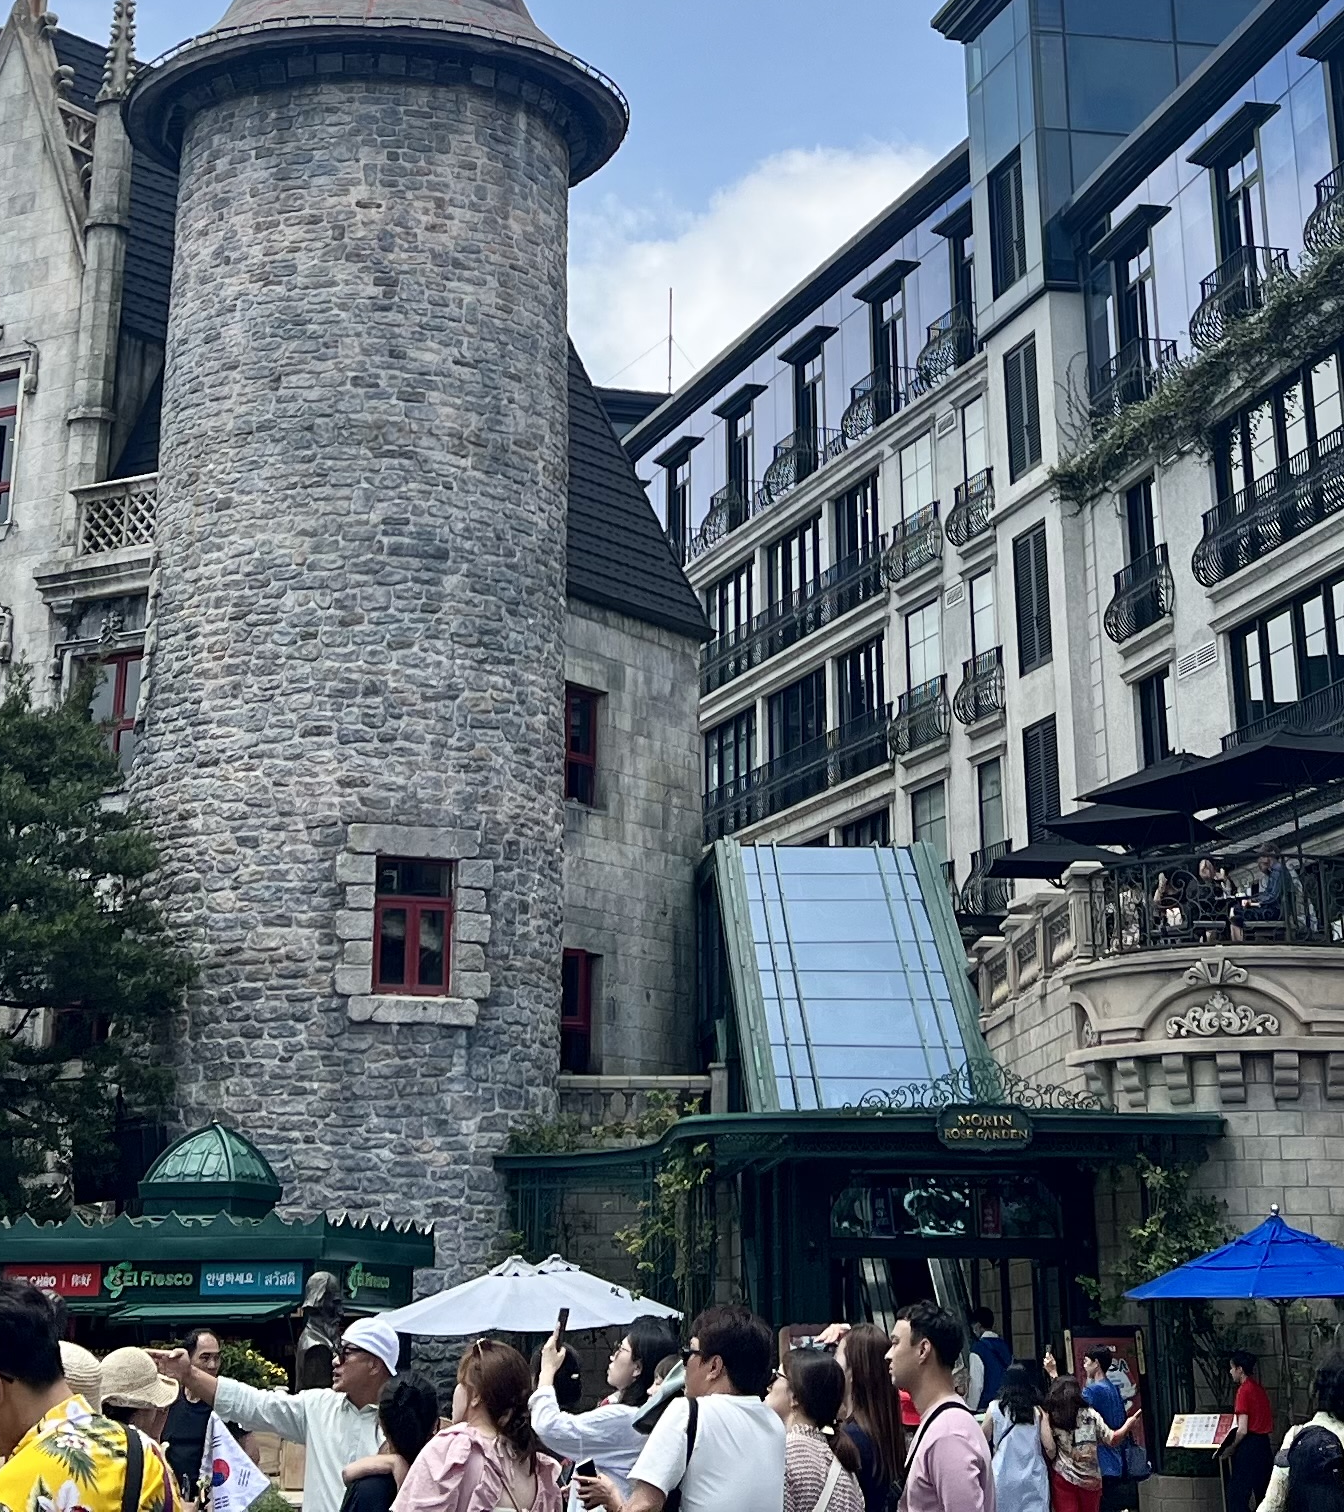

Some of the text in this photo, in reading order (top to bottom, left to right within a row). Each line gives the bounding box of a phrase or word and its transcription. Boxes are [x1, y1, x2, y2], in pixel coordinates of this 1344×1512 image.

[957, 1113, 1013, 1127] MORIN
[944, 1128, 1028, 1140] ROSE GARDEN
[140, 1271, 194, 1287] Fresco
[205, 1271, 255, 1287] 안녕하세요
